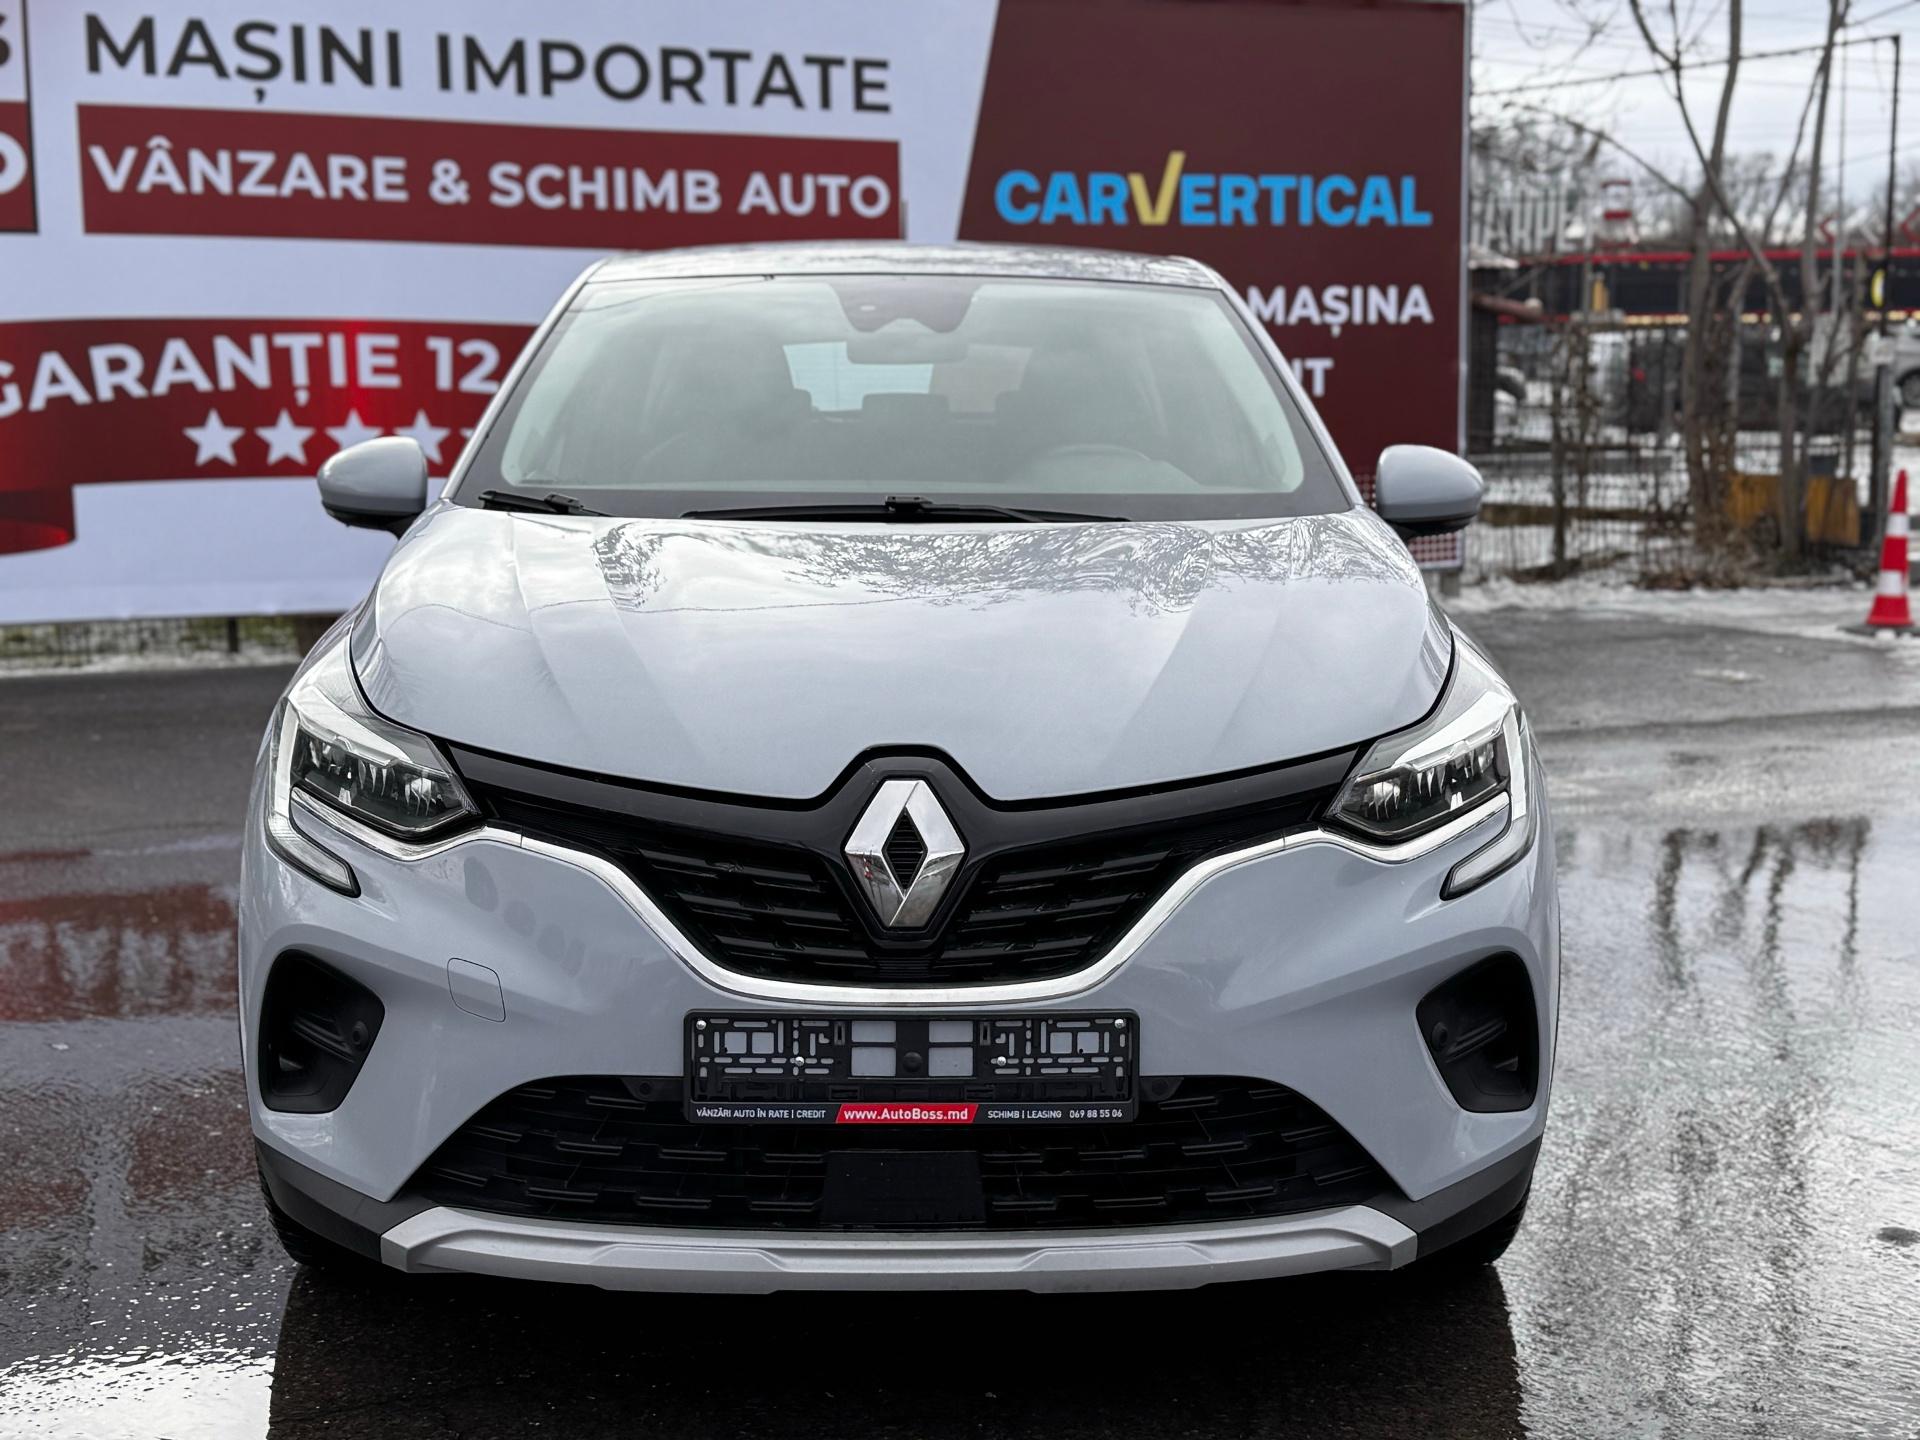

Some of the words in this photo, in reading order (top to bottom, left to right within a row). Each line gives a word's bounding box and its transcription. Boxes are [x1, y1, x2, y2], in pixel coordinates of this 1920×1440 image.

[84, 14, 402, 103] MAȘINI
[437, 33, 892, 113] IMPORTATE
[89, 136, 409, 201] VÂNZARE
[429, 159, 470, 204] &
[488, 162, 721, 213] SCHIMB
[738, 171, 891, 218] AUTO
[994, 150, 1433, 227] CARVERTICAL
[1247, 284, 1434, 338] MAȘINA
[426, 335, 500, 394] 12
[733, 1109, 755, 1118] AUTO
[768, 1109, 790, 1119] RATE
[796, 1109, 826, 1119] CREDIT
[843, 1107, 969, 1120] www.AutoBoss.md
[987, 1109, 1020, 1119] SCHIMB
[1027, 1109, 1062, 1119] LEASING
[1069, 1109, 1085, 1119] 069
